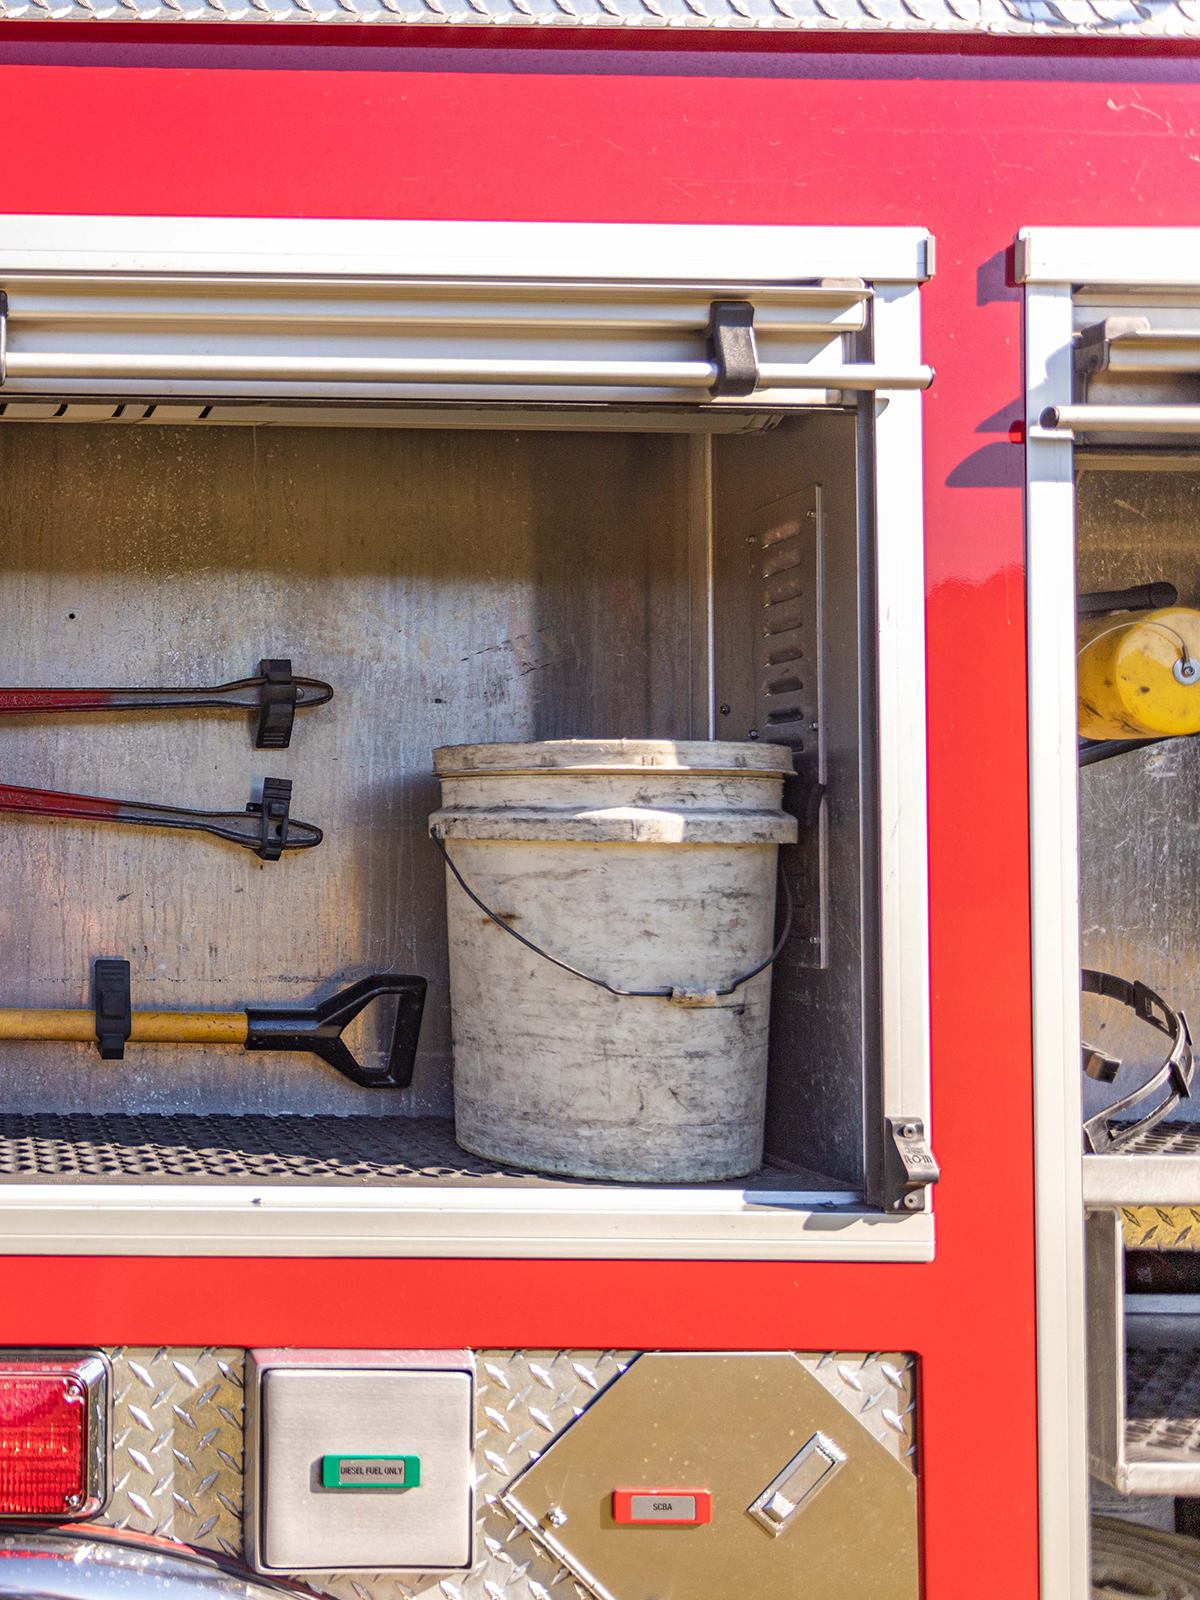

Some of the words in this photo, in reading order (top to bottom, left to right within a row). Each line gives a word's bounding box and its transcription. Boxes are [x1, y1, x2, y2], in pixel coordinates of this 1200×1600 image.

[341, 1466, 365, 1475] DIESEL
[366, 1466, 382, 1475] FUEL
[384, 1466, 403, 1475] ONLY
[652, 1502, 673, 1512] SCBA
